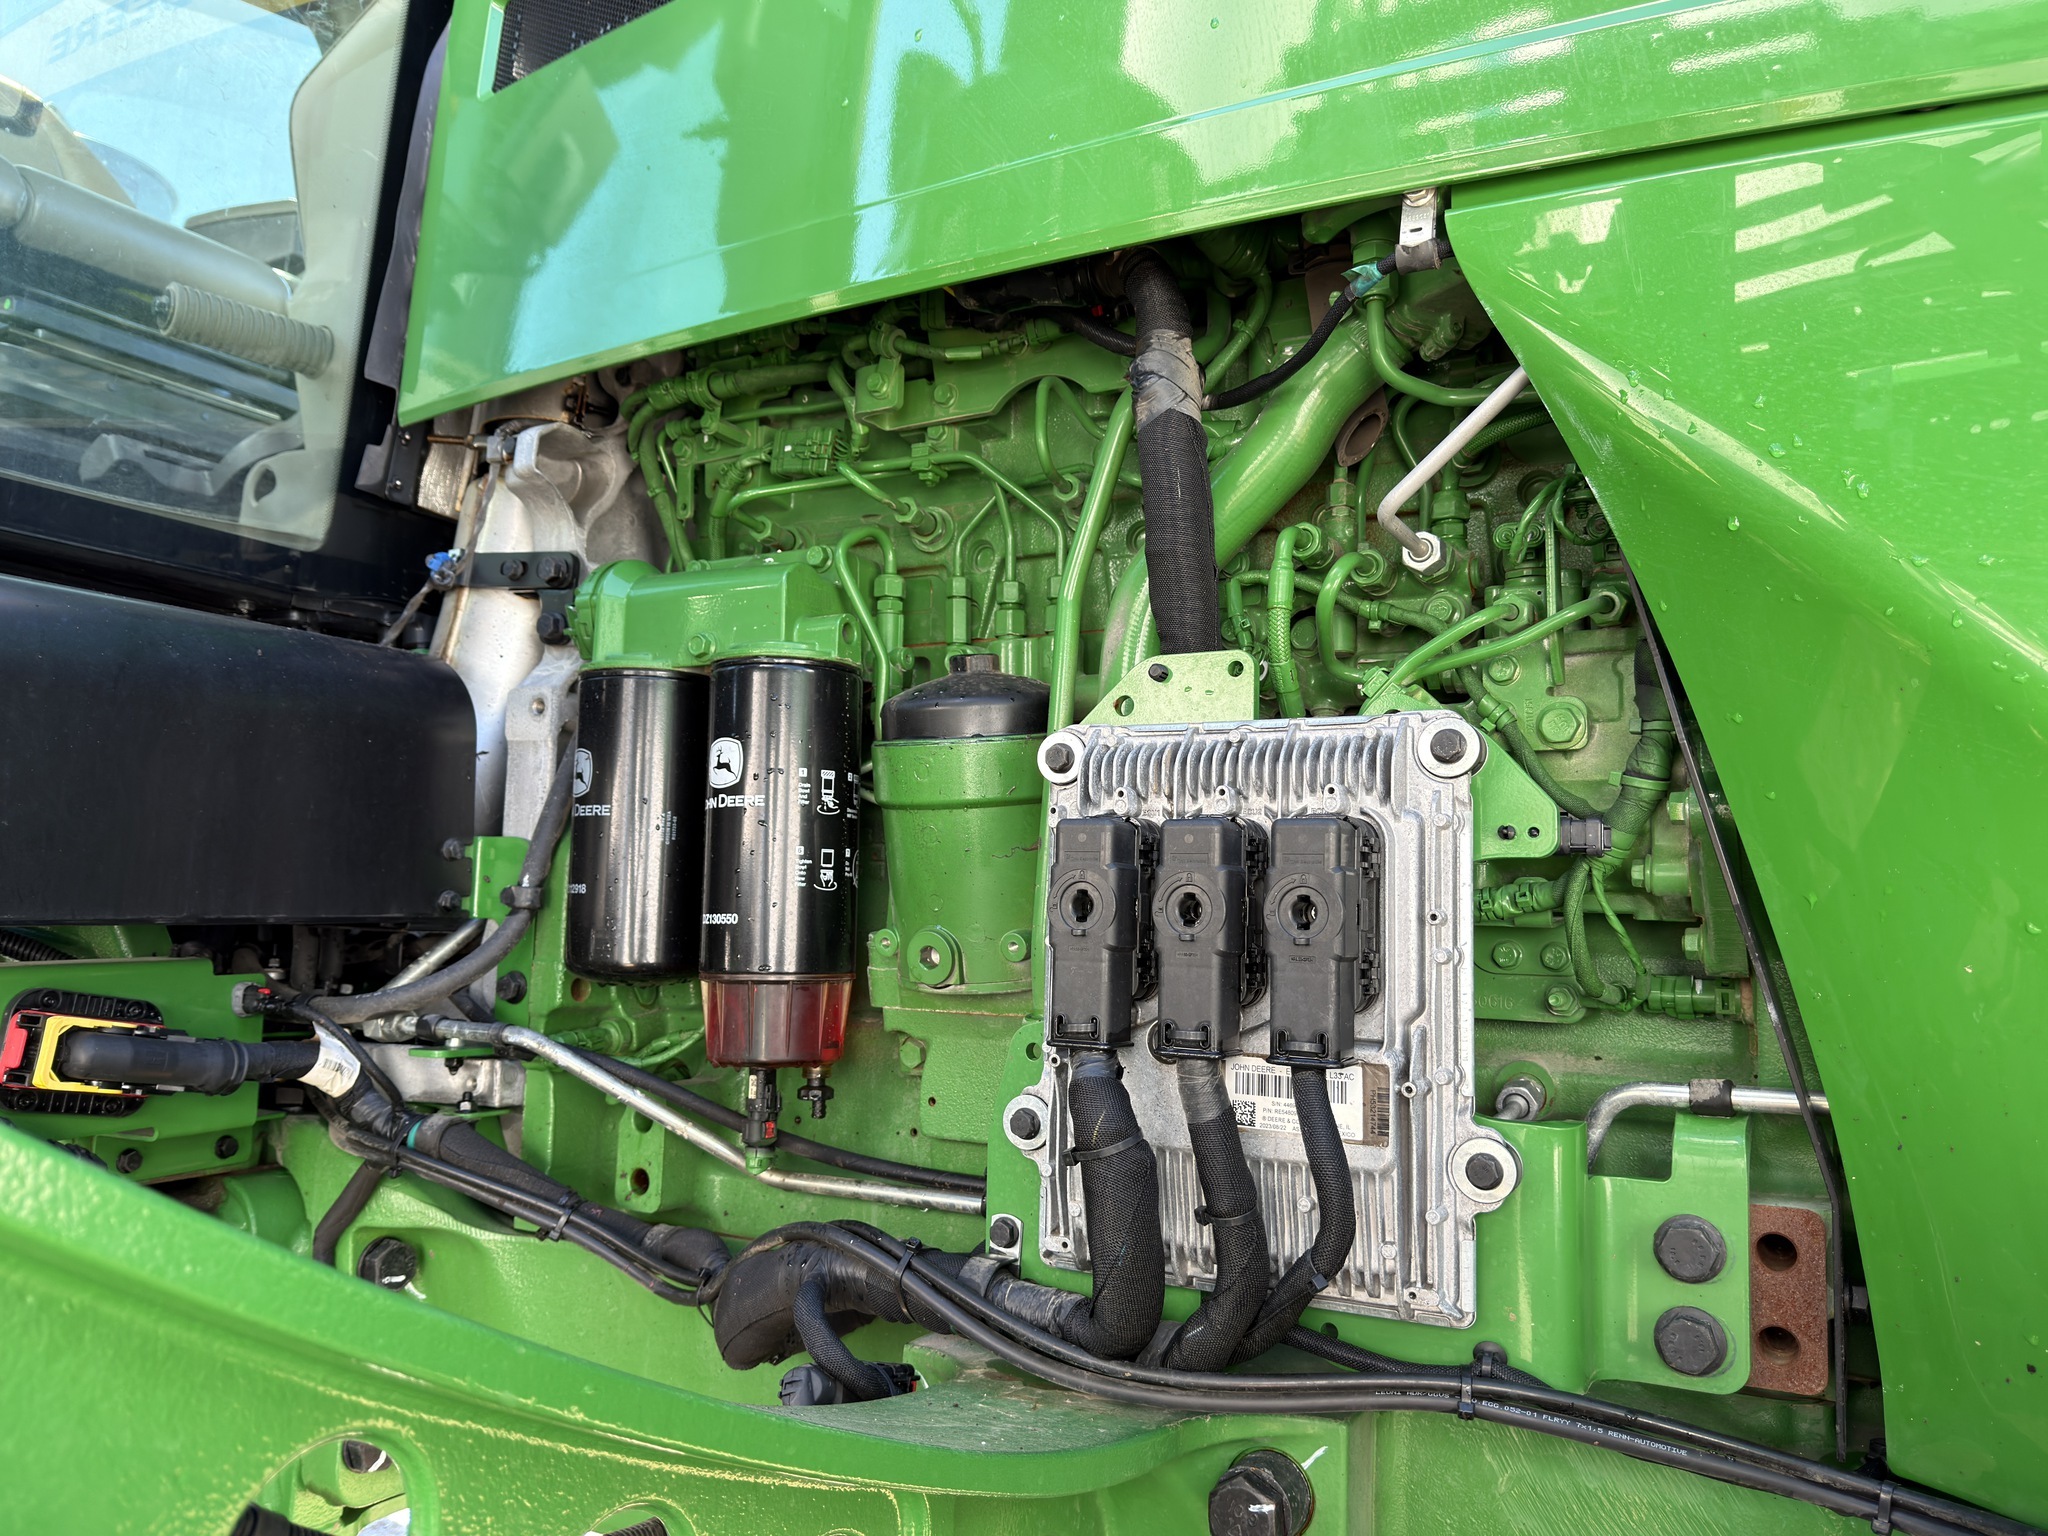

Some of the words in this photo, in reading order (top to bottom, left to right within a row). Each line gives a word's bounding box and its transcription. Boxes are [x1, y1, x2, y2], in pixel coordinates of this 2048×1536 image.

[718, 794, 766, 808] DEERE
[574, 804, 611, 817] DEERE
[1231, 1063, 1250, 1072] JOHN
[1252, 1064, 1276, 1074] DEERE
[1542, 1414, 1571, 1426] FLRYY
[1607, 1430, 1688, 1456] RENN-AUTOMOTIVE
